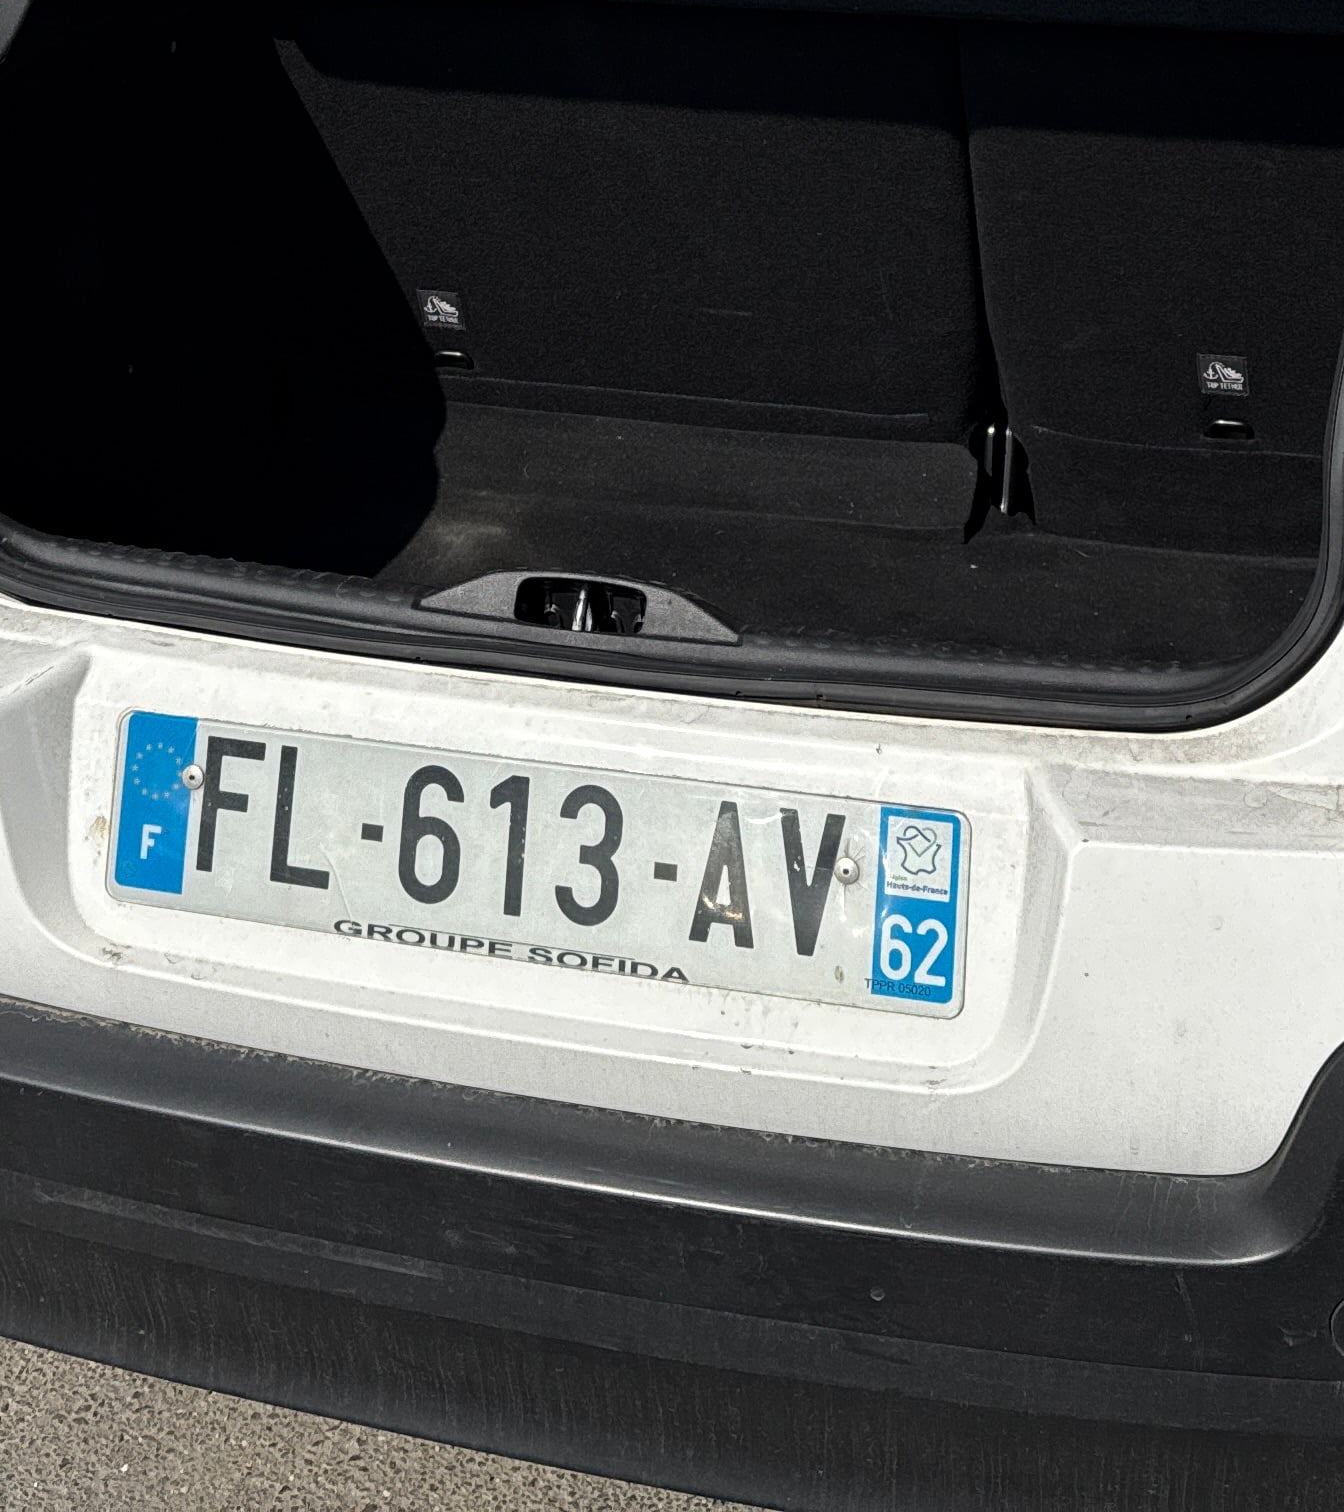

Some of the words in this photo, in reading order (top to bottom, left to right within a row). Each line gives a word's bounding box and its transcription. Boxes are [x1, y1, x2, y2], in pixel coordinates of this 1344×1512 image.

[140, 824, 162, 860] F
[195, 735, 847, 958] FL-613-AV
[886, 880, 948, 896] Hauts-de-France
[334, 920, 514, 960] GROUPE
[527, 946, 690, 984] SOFIDA
[880, 914, 948, 987] 62
[864, 978, 896, 992] TPPR
